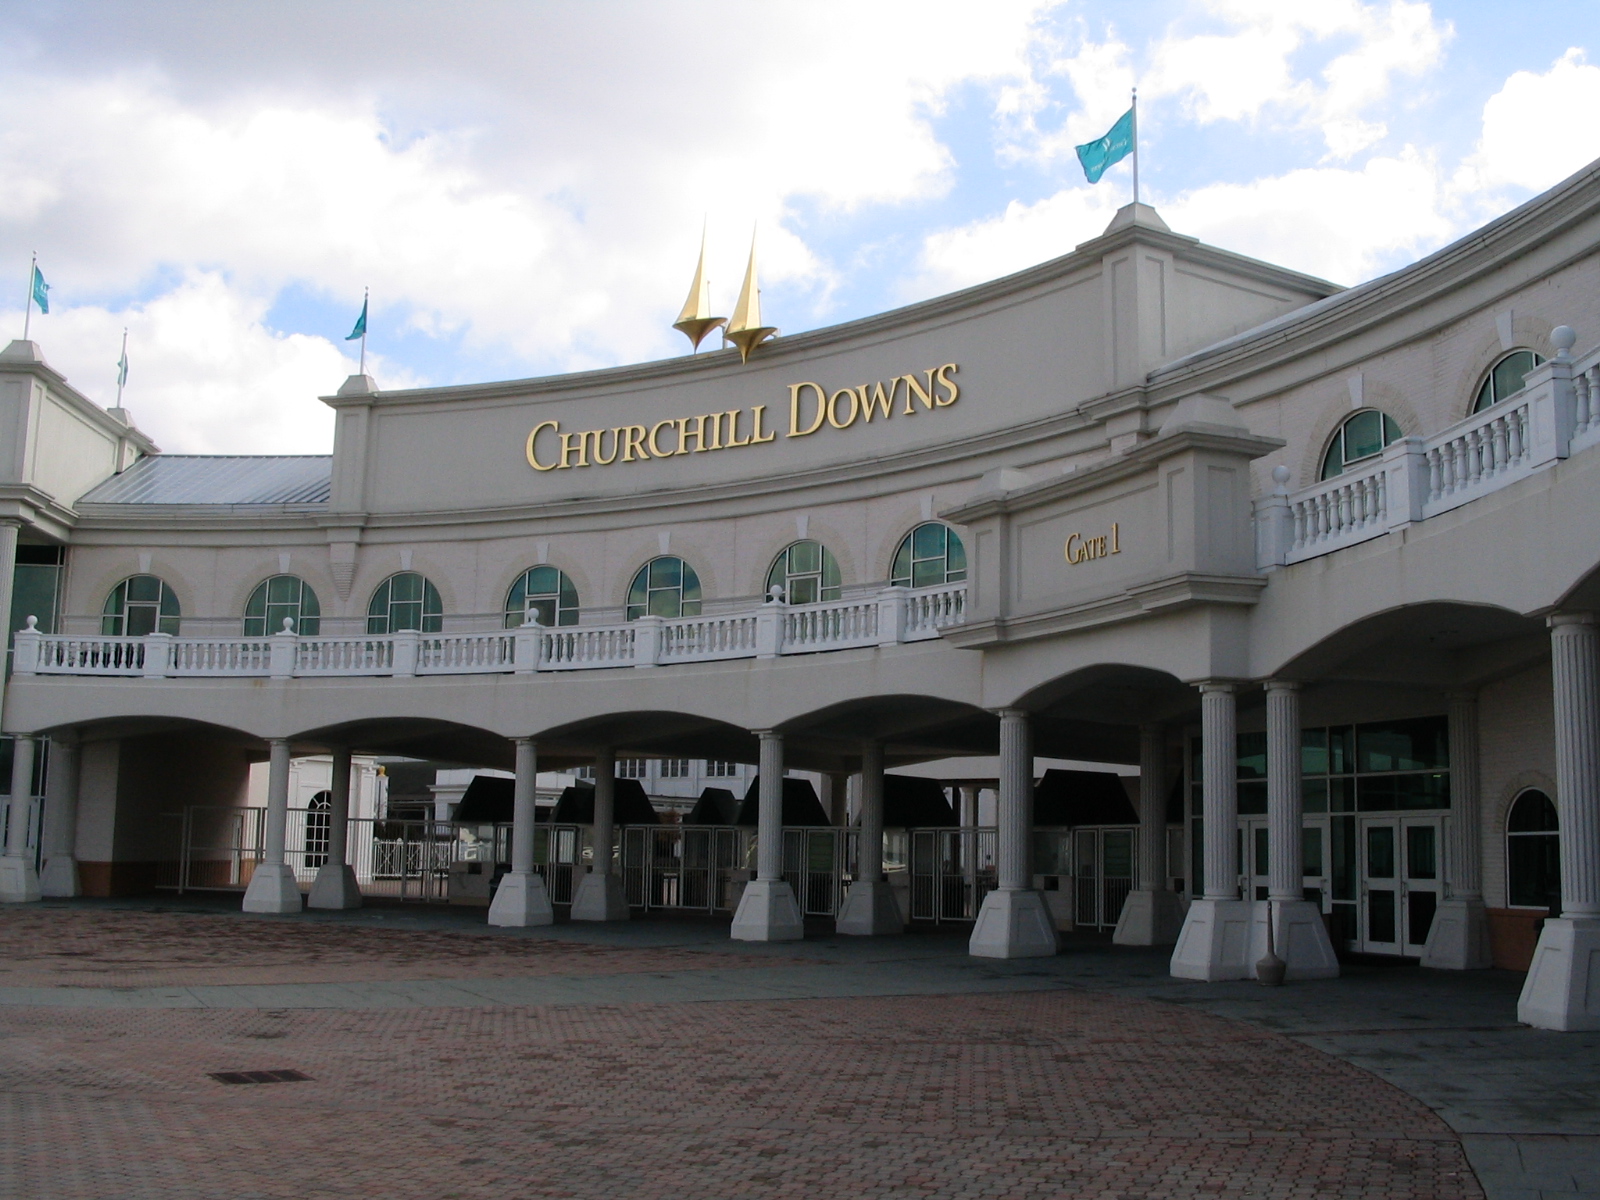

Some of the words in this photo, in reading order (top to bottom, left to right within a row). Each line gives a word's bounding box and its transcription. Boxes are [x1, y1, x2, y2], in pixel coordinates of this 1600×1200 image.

[525, 404, 775, 471] CHURCHILL
[787, 363, 960, 438] DOWNS
[1065, 532, 1107, 565] GATE
[1111, 522, 1121, 554] 1
